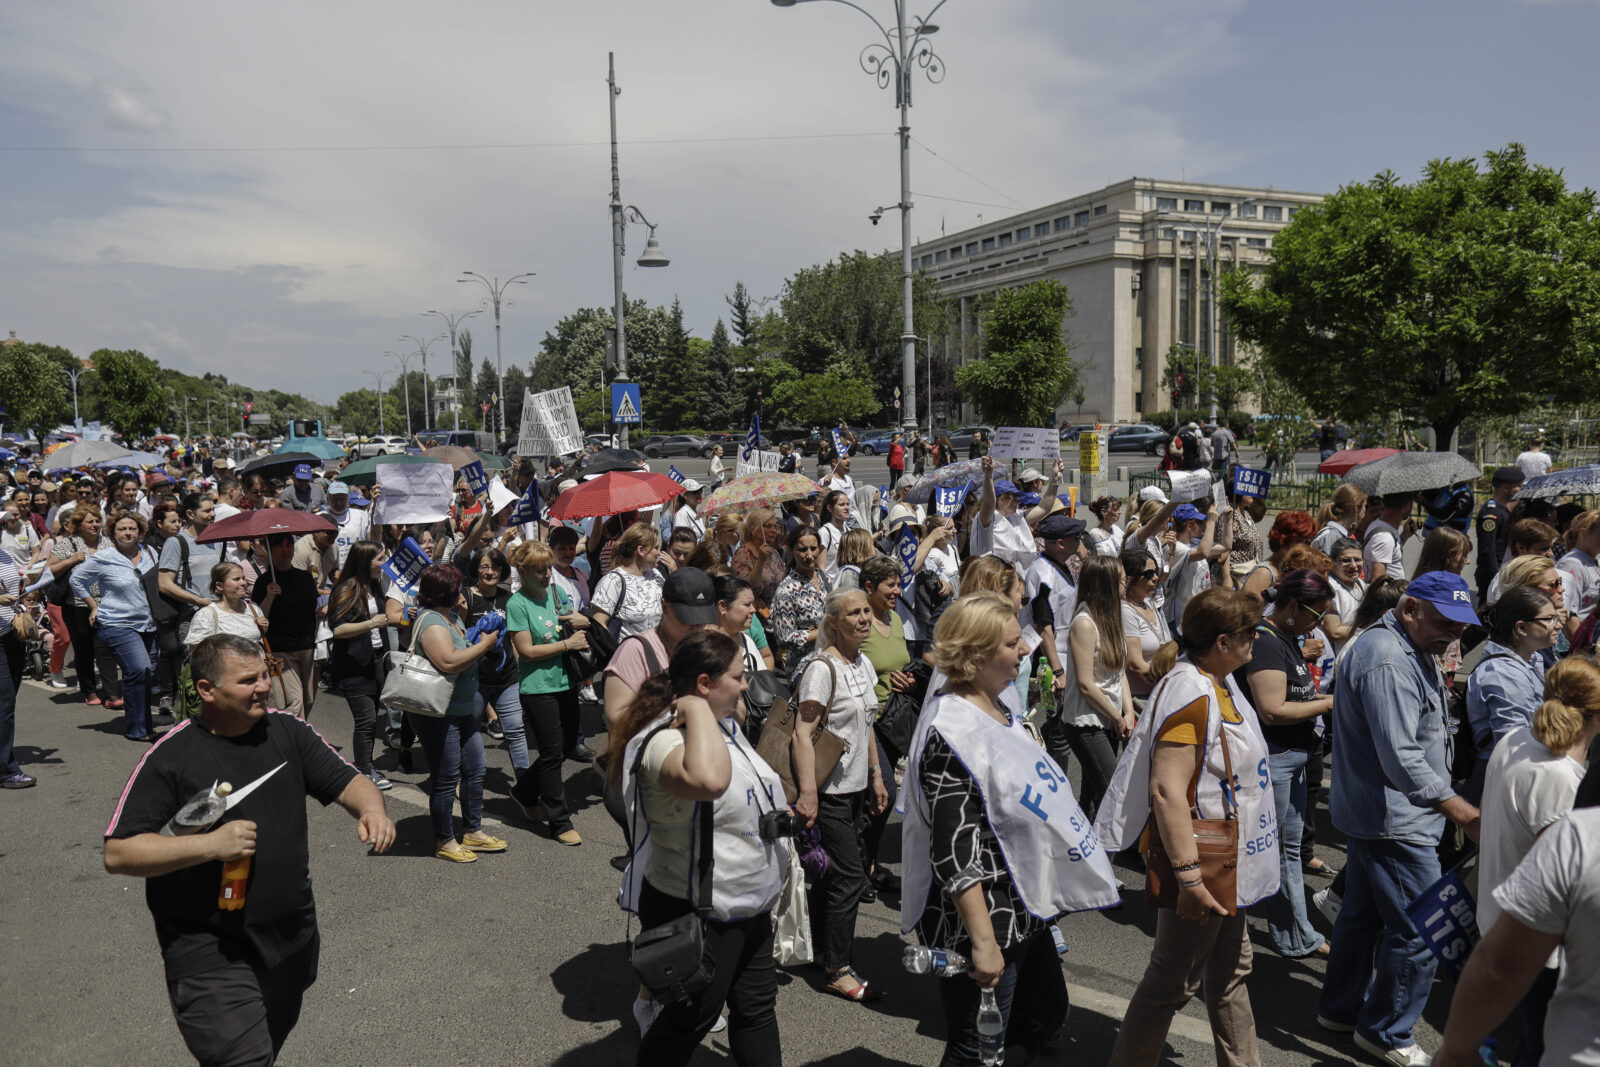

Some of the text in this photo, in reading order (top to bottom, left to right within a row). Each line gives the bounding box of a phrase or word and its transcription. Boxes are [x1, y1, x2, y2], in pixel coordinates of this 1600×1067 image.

[1239, 470, 1265, 486] FSLI
[1259, 488, 1266, 496] 3
[389, 547, 416, 576] FSLI
[395, 559, 423, 588] SECTOR
